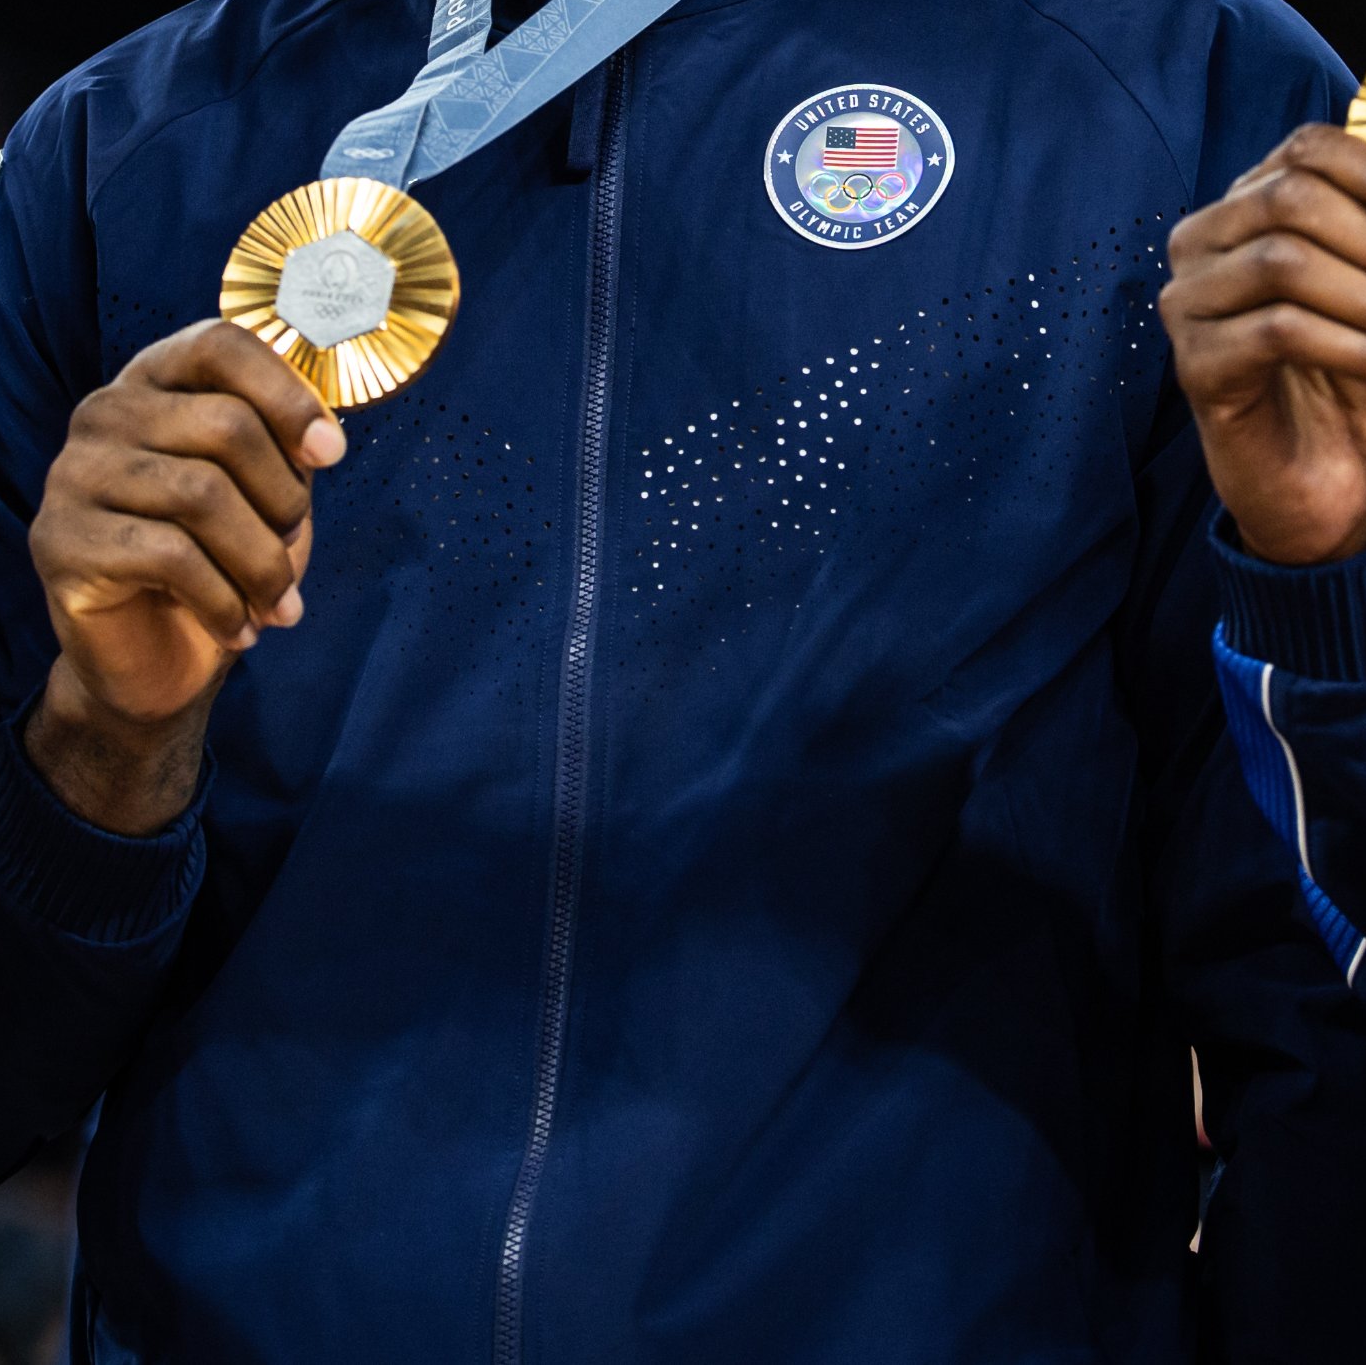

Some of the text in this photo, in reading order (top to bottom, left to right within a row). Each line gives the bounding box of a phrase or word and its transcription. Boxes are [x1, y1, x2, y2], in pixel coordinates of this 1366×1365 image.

[794, 94, 931, 135] UNITED STATES
[789, 200, 920, 239] OLYMPIC TEAM
